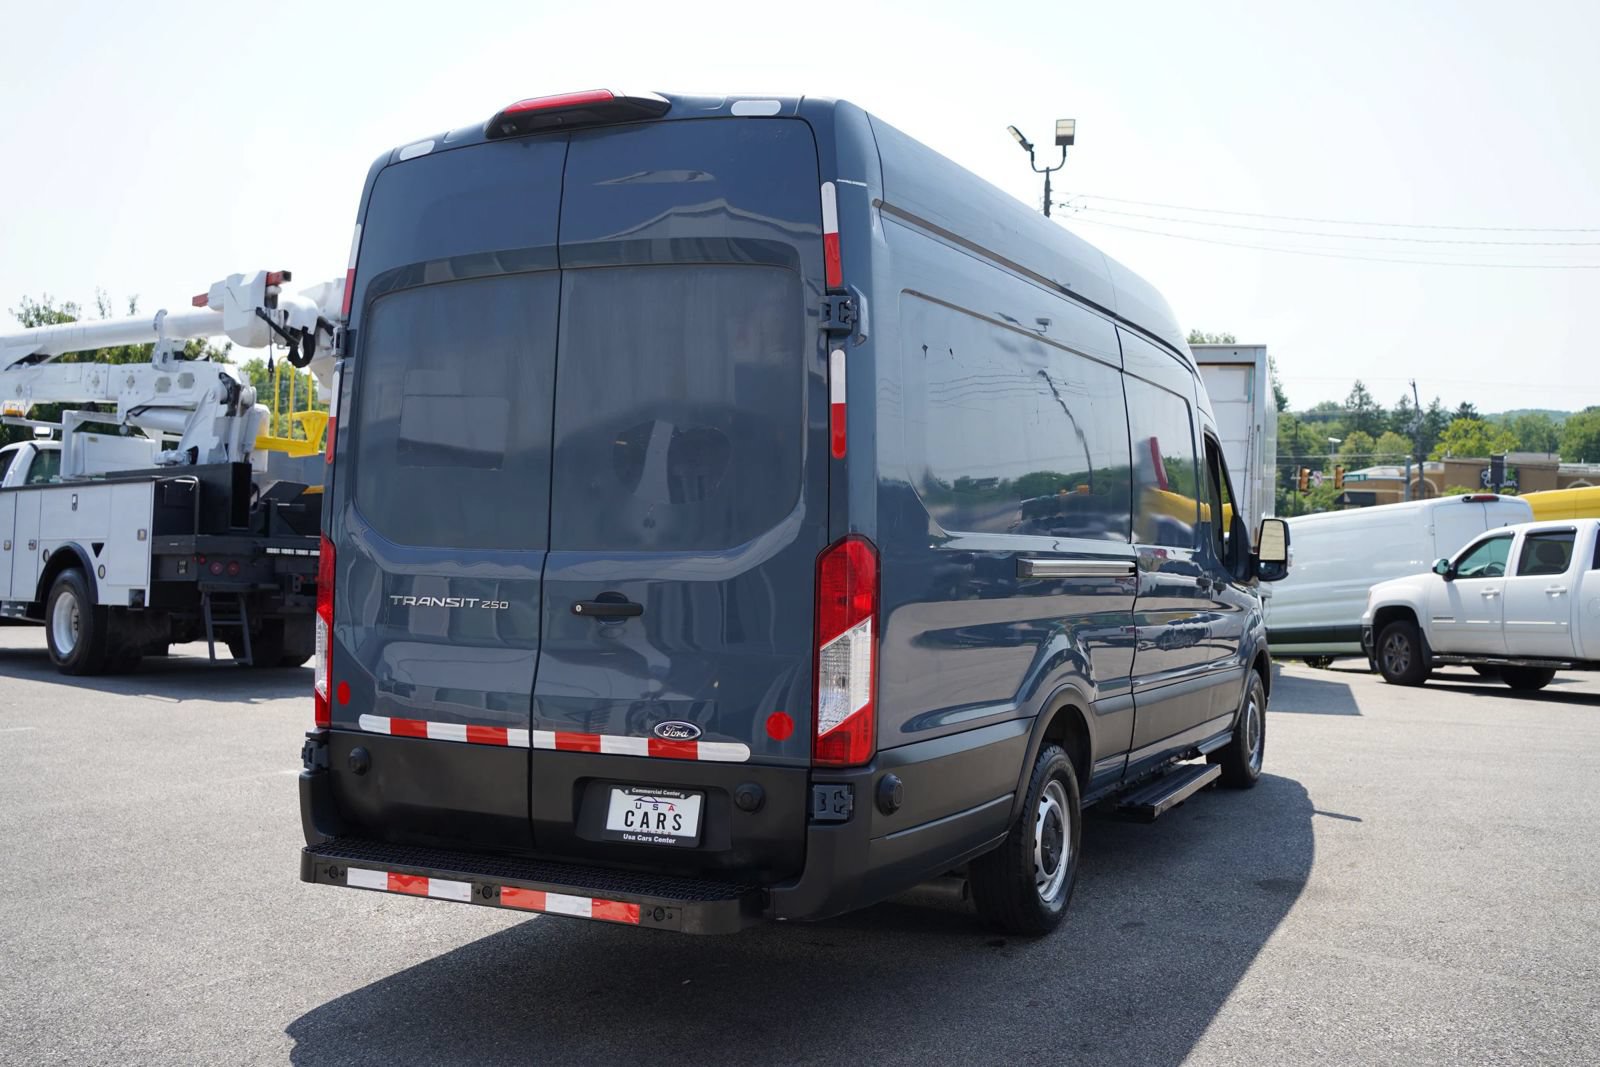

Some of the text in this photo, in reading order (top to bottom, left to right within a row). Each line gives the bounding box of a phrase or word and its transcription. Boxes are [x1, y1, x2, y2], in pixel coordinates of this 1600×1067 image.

[389, 595, 509, 610] TRANSIT 250
[663, 725, 689, 738] Ford
[631, 787, 681, 797] Commercial Center
[624, 810, 682, 831] CARS
[623, 833, 677, 844] Usa Cars Center
